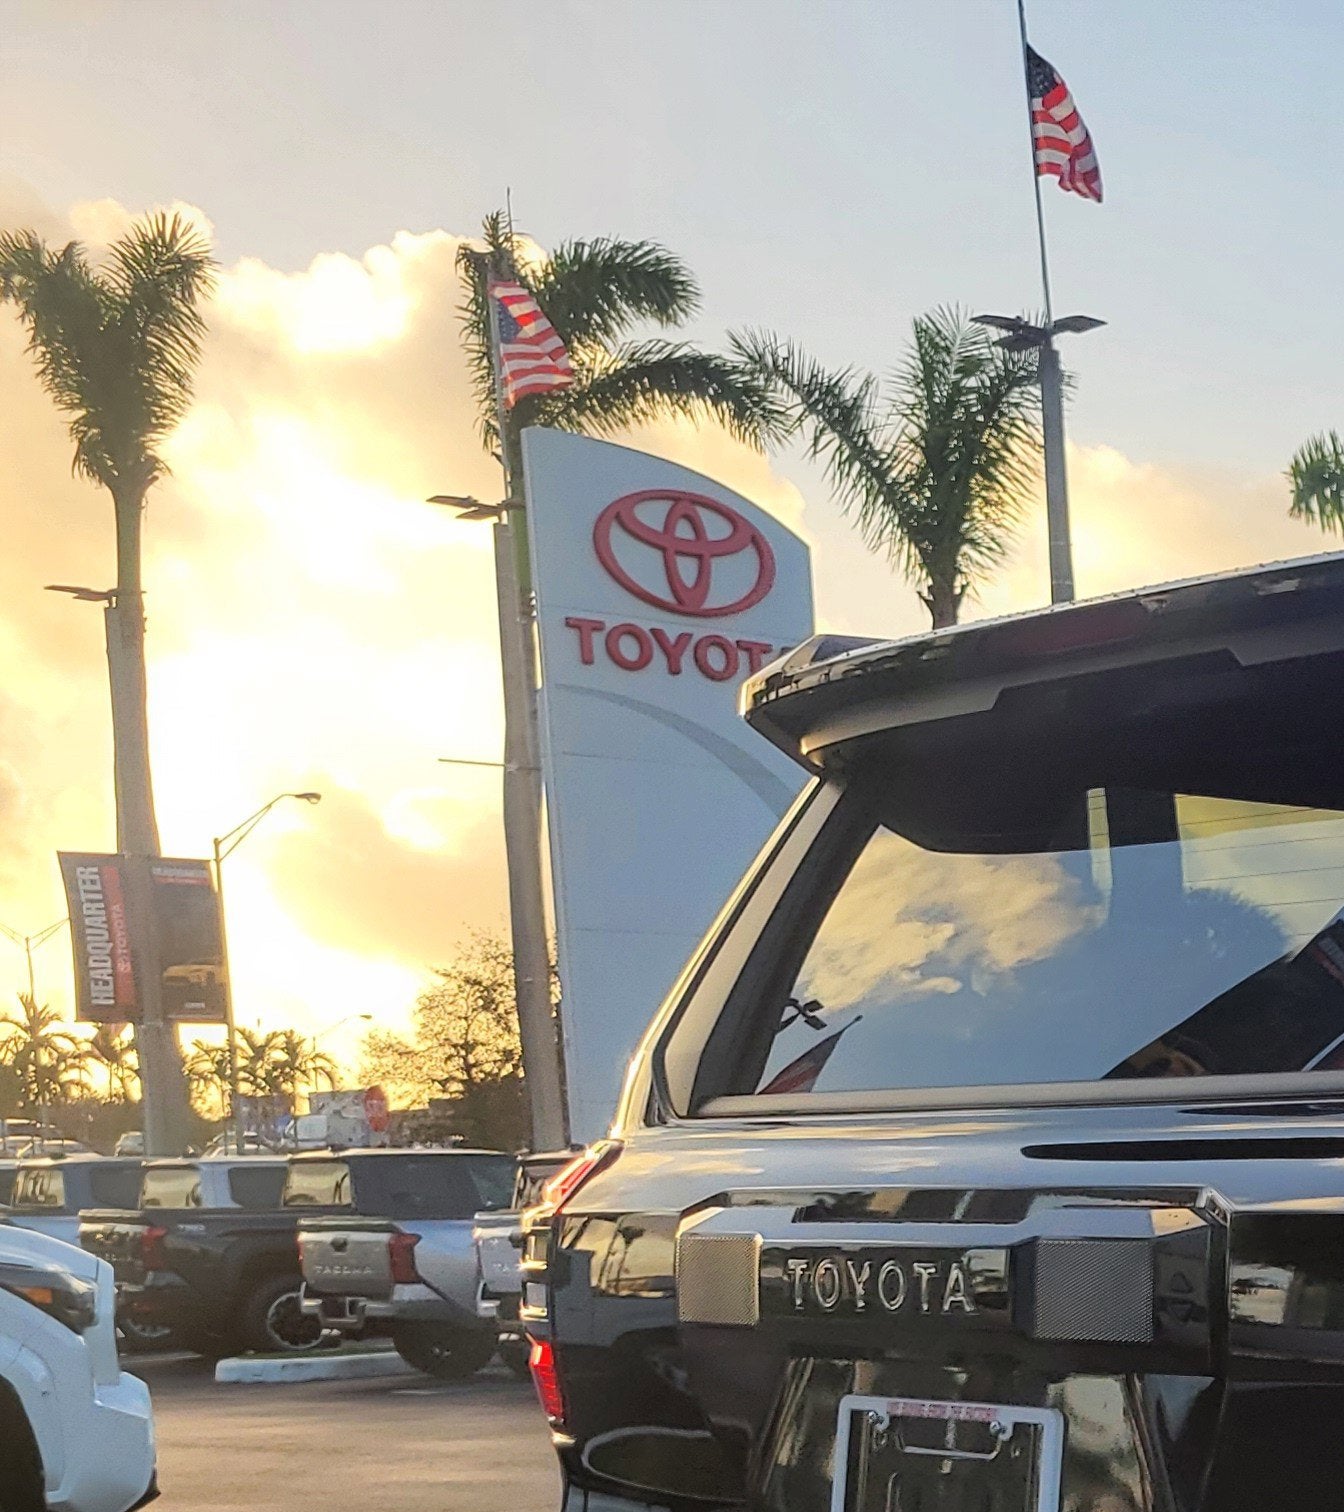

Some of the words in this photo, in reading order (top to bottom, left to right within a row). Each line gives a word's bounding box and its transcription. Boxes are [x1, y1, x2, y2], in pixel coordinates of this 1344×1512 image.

[565, 617, 795, 682] TOYOT
[76, 866, 116, 1006] HEADQUARTER
[787, 1257, 977, 1315] TOYOTA
